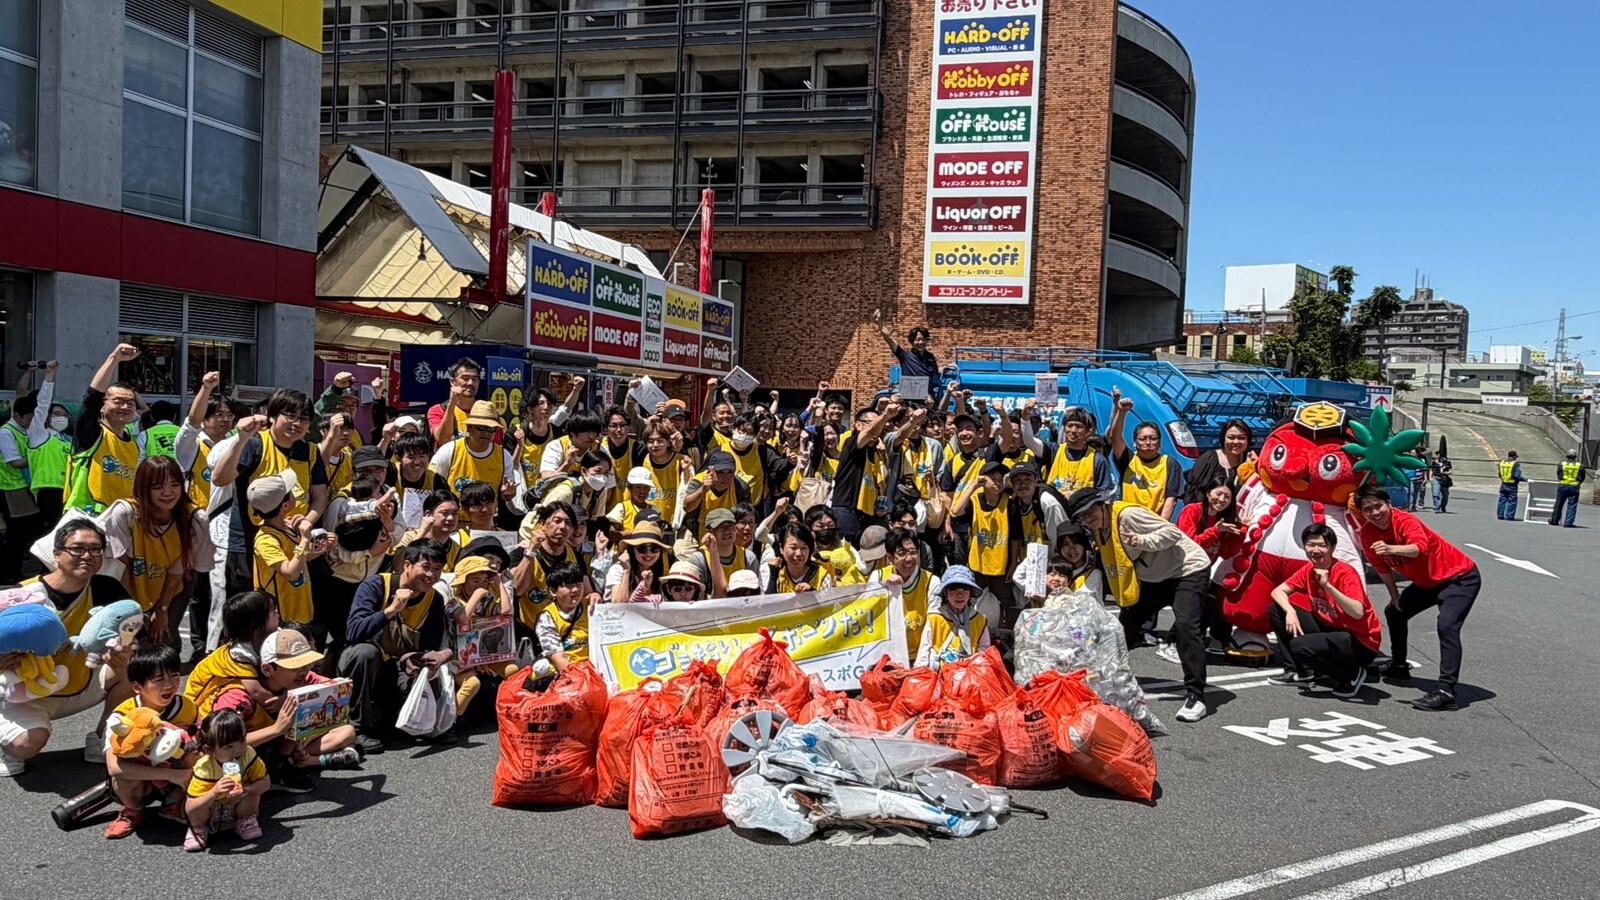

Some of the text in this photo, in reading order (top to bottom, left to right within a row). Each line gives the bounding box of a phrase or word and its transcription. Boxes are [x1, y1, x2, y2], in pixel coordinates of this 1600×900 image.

[997, 73, 1029, 87] OFF
[941, 119, 972, 133] OFF
[991, 161, 1023, 174] OFF
[936, 205, 1022, 223] Liquor OFF
[595, 281, 613, 302] OFF
[647, 297, 661, 315] ECO
[569, 322, 588, 342] OFF
[622, 331, 639, 348] OFF
